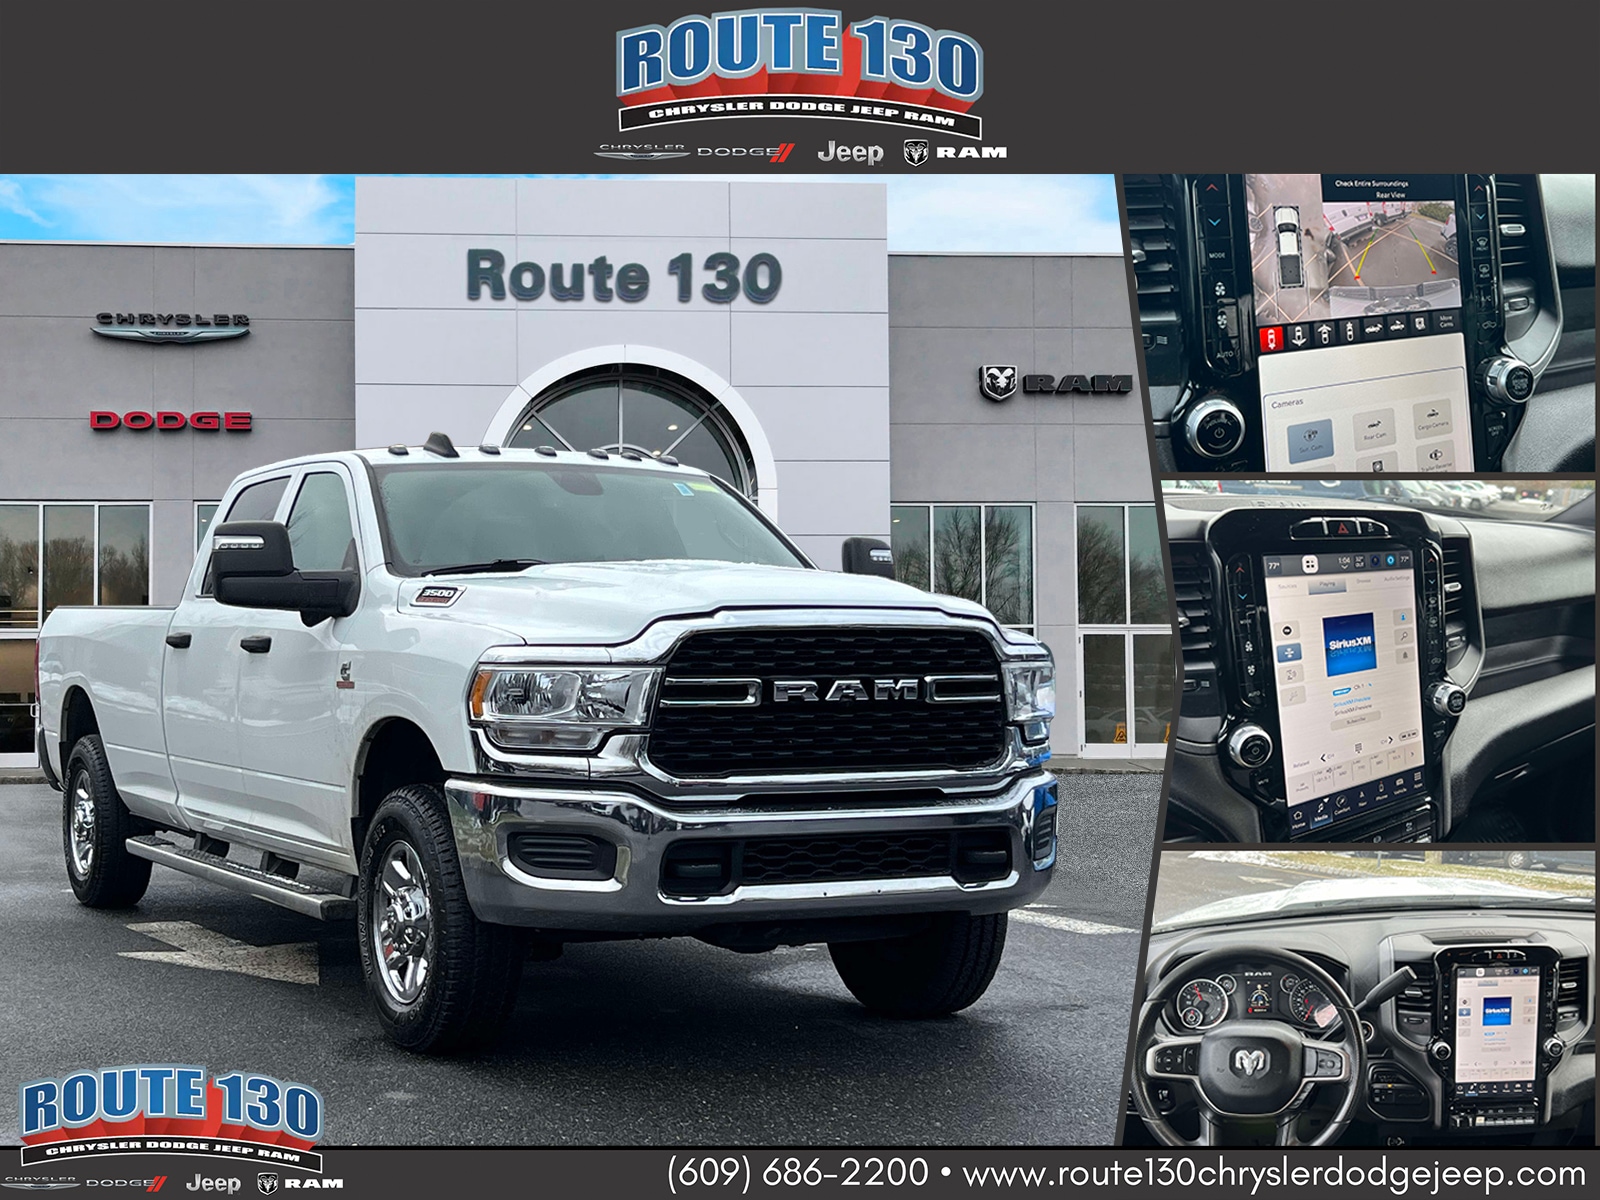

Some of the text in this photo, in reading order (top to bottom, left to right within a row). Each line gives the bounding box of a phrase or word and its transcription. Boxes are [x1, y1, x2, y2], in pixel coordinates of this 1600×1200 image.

[1372, 180, 1408, 188] Surroundings
[467, 249, 782, 304] Route 130
[96, 312, 250, 326] CHRYSLER
[1216, 350, 1235, 359] AUTO
[1023, 374, 1133, 394] RAM
[1271, 398, 1304, 410] Cameras
[90, 411, 253, 431] DODGE
[421, 589, 455, 598] 3500
[1329, 636, 1372, 650] SiriusXM
[773, 679, 919, 702] RAM
